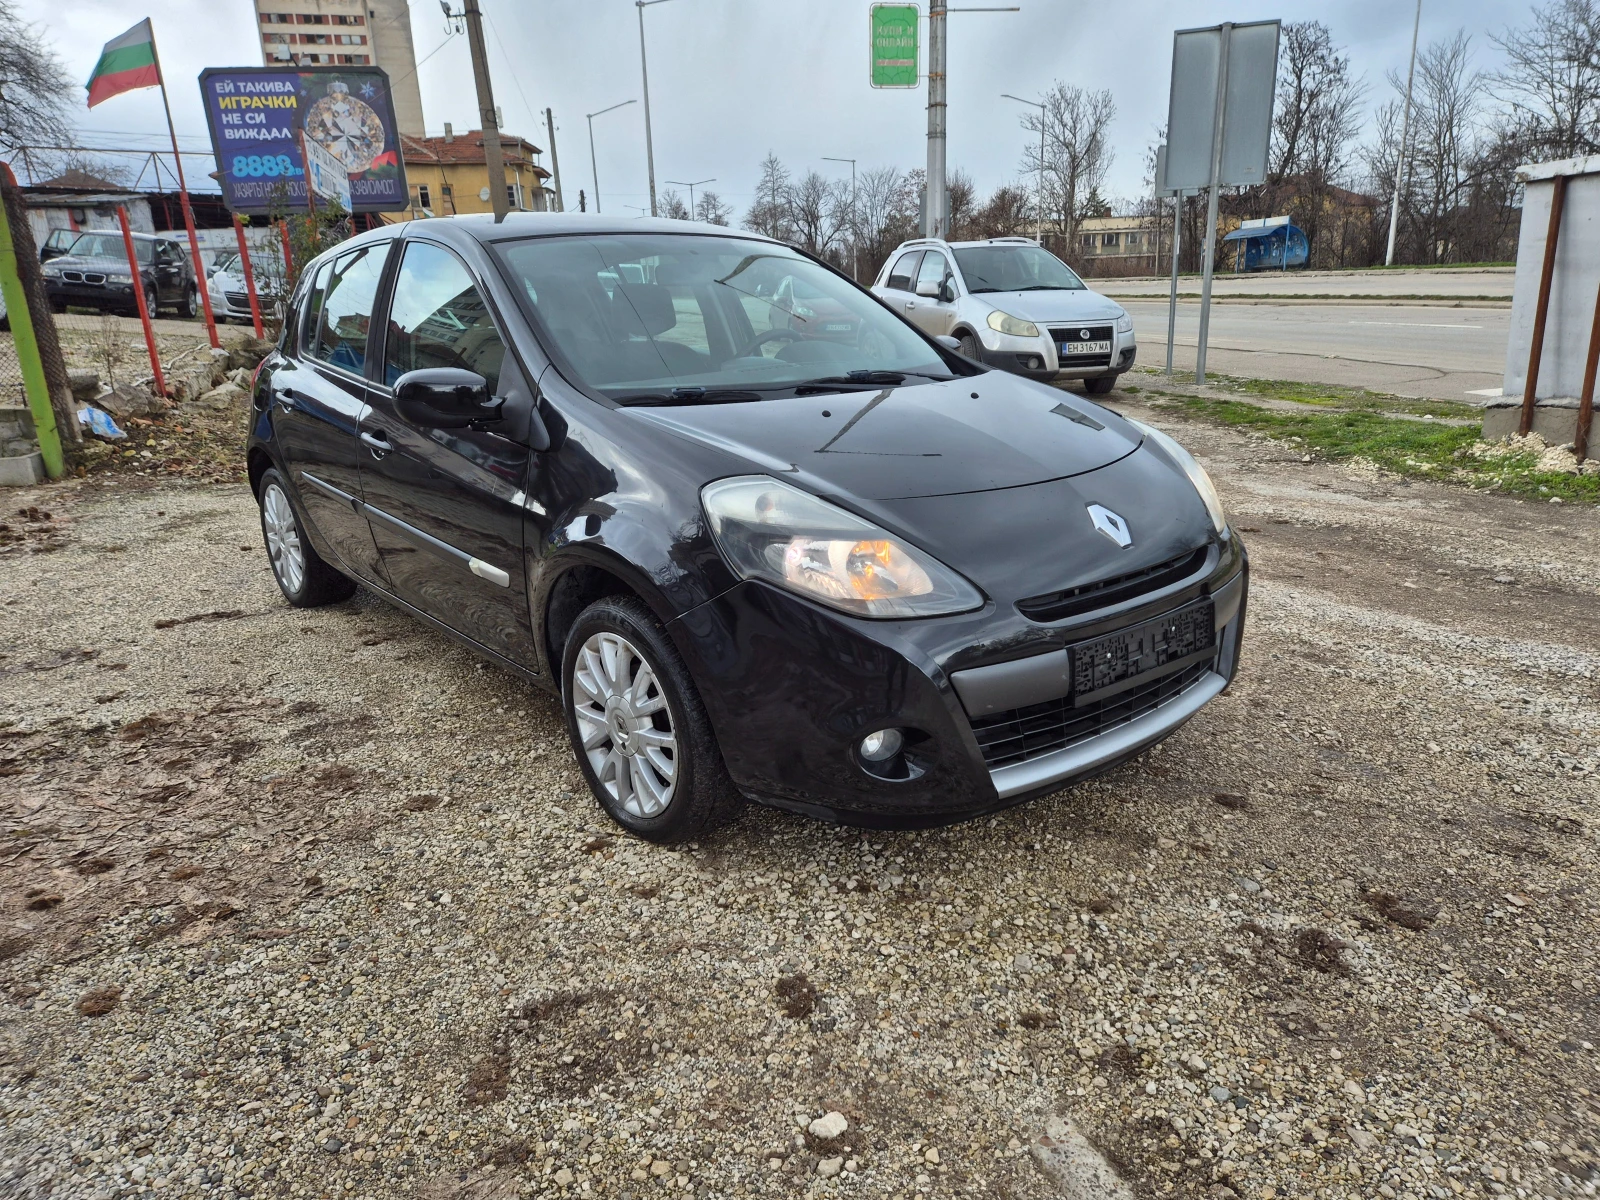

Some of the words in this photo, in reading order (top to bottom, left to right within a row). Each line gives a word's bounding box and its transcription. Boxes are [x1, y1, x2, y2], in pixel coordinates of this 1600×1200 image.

[215, 80, 235, 93] ЕЙ
[237, 81, 295, 93] ТАКИВА
[218, 95, 298, 110] ИГРАЧКИ
[221, 113, 242, 125] НЕ
[245, 112, 267, 124] СИ
[224, 127, 292, 141] ВИЖДАЛ
